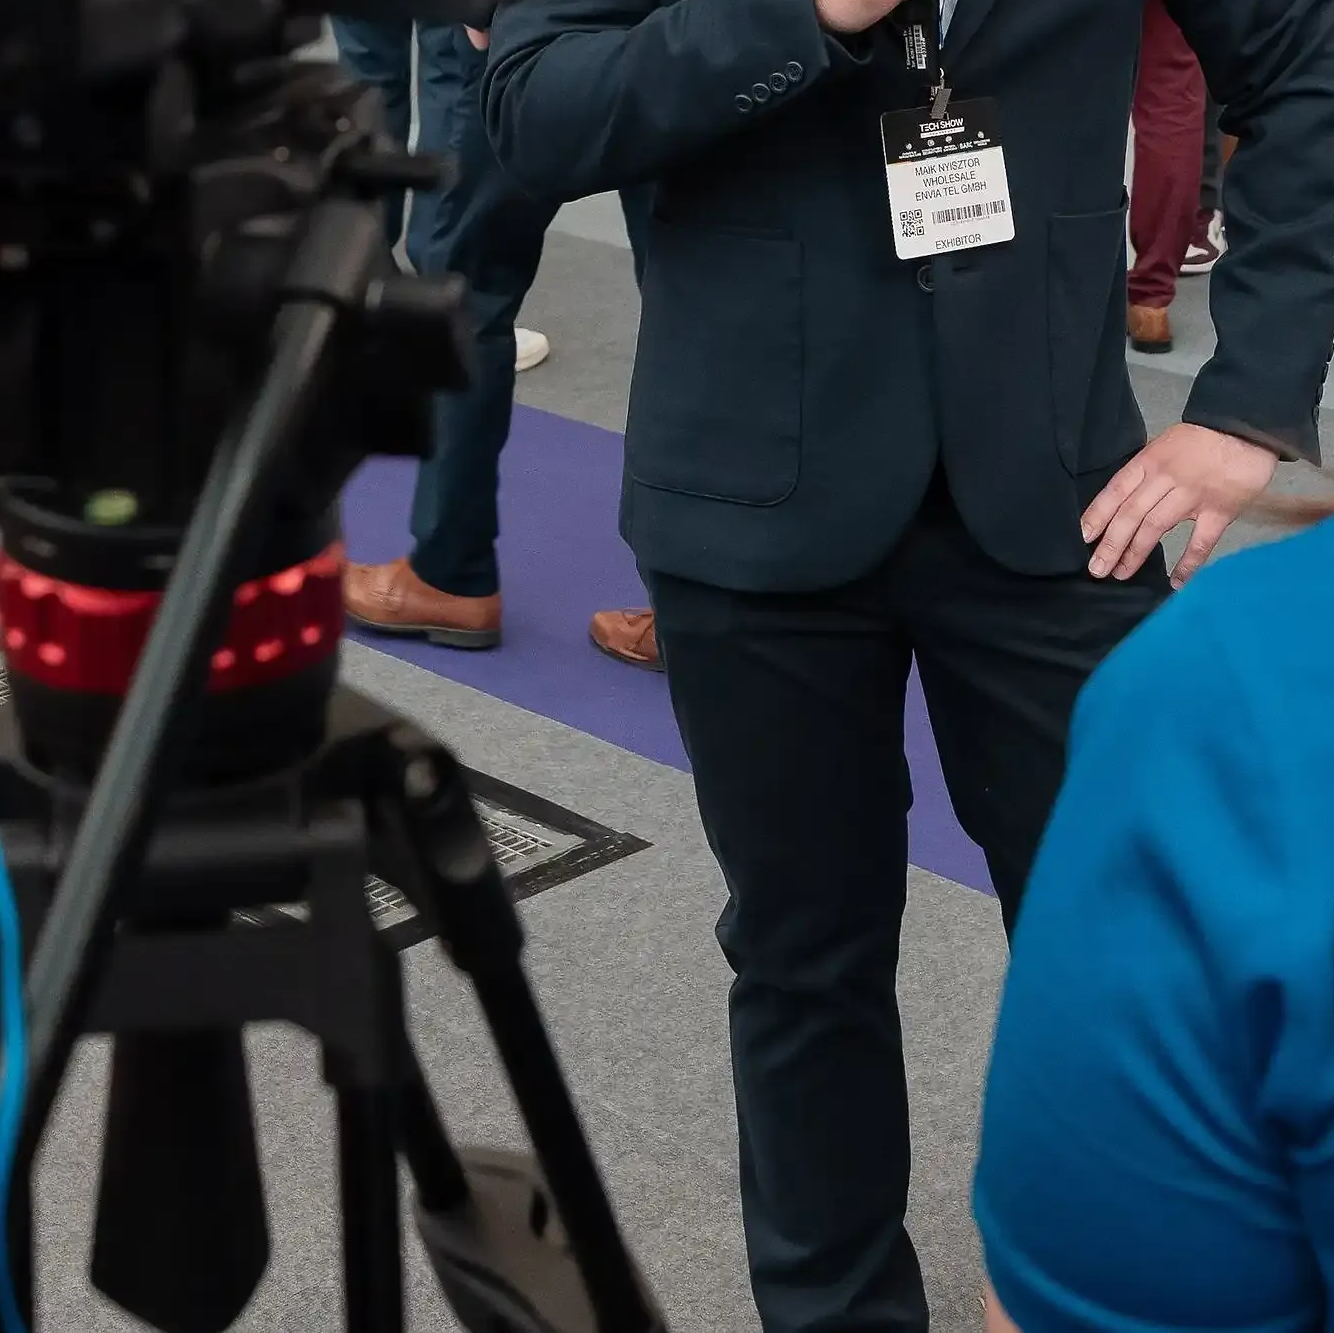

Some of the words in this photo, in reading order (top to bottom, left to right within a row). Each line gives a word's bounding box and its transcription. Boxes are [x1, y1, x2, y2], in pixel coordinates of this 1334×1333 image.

[919, 121, 940, 132] TECH
[940, 118, 964, 129] SHOW
[915, 164, 937, 177] MAIK
[938, 157, 981, 173] NYISZTOR
[923, 170, 976, 188] WHOLESALE
[915, 190, 943, 202] ENVIA
[943, 186, 959, 197] TEL
[961, 181, 987, 194] GMBH
[935, 233, 982, 250] EXHIBITOR
